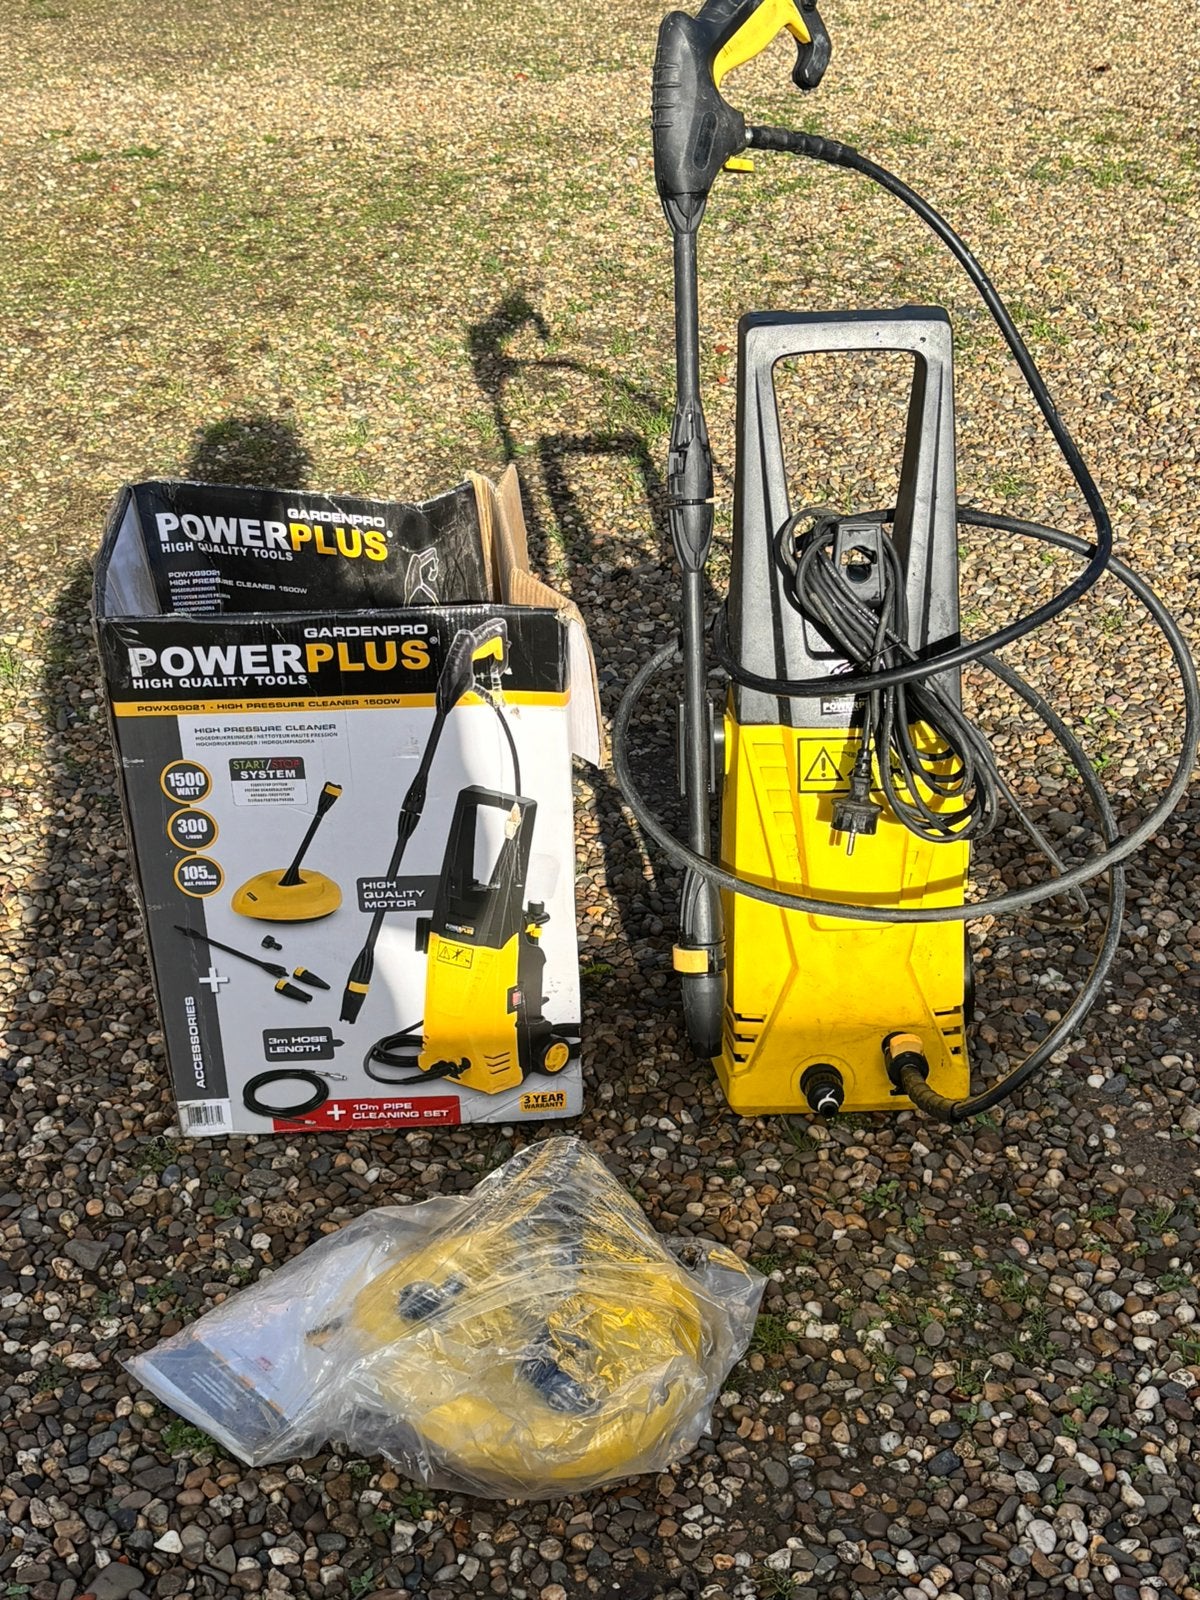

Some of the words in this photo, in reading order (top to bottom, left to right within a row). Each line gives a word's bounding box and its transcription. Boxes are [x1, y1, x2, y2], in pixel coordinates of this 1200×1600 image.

[287, 508, 386, 528] GARDENPRO
[161, 541, 194, 553] HIGH
[198, 542, 248, 557] QUALITY
[252, 548, 294, 562] TOOLS
[169, 578, 190, 586] HIGH
[236, 580, 276, 590] CLEANER
[279, 585, 308, 594] 1500W
[304, 624, 428, 638] GARDENPRO
[133, 677, 174, 690] HIGH
[179, 675, 249, 689] QUALITY
[254, 674, 308, 687] TOOLS
[137, 704, 206, 712] POWXG9021
[216, 702, 244, 710] HIGH
[246, 701, 305, 710] PRESSURE
[308, 699, 360, 708] CLEANER
[364, 698, 401, 706] 1500W
[167, 772, 206, 787] 1500
[240, 769, 296, 780] SYSTEM
[176, 787, 200, 796] WATT
[177, 818, 208, 834] 300
[362, 881, 397, 890] HIGH
[363, 890, 425, 899] QUALITY
[364, 900, 417, 909] MOTOR
[184, 996, 206, 1089] ACCESSORIES
[268, 1037, 288, 1045] 3m
[291, 1035, 328, 1044] HOSE
[269, 1044, 322, 1054] LENGTH
[523, 1095, 531, 1104] 3
[533, 1093, 564, 1103] YEAR
[352, 1103, 380, 1111] 10m
[383, 1102, 413, 1110] PIPE
[524, 1101, 564, 1110] WARRANTY
[352, 1110, 420, 1120] CLEANING
[423, 1109, 450, 1118] SET
